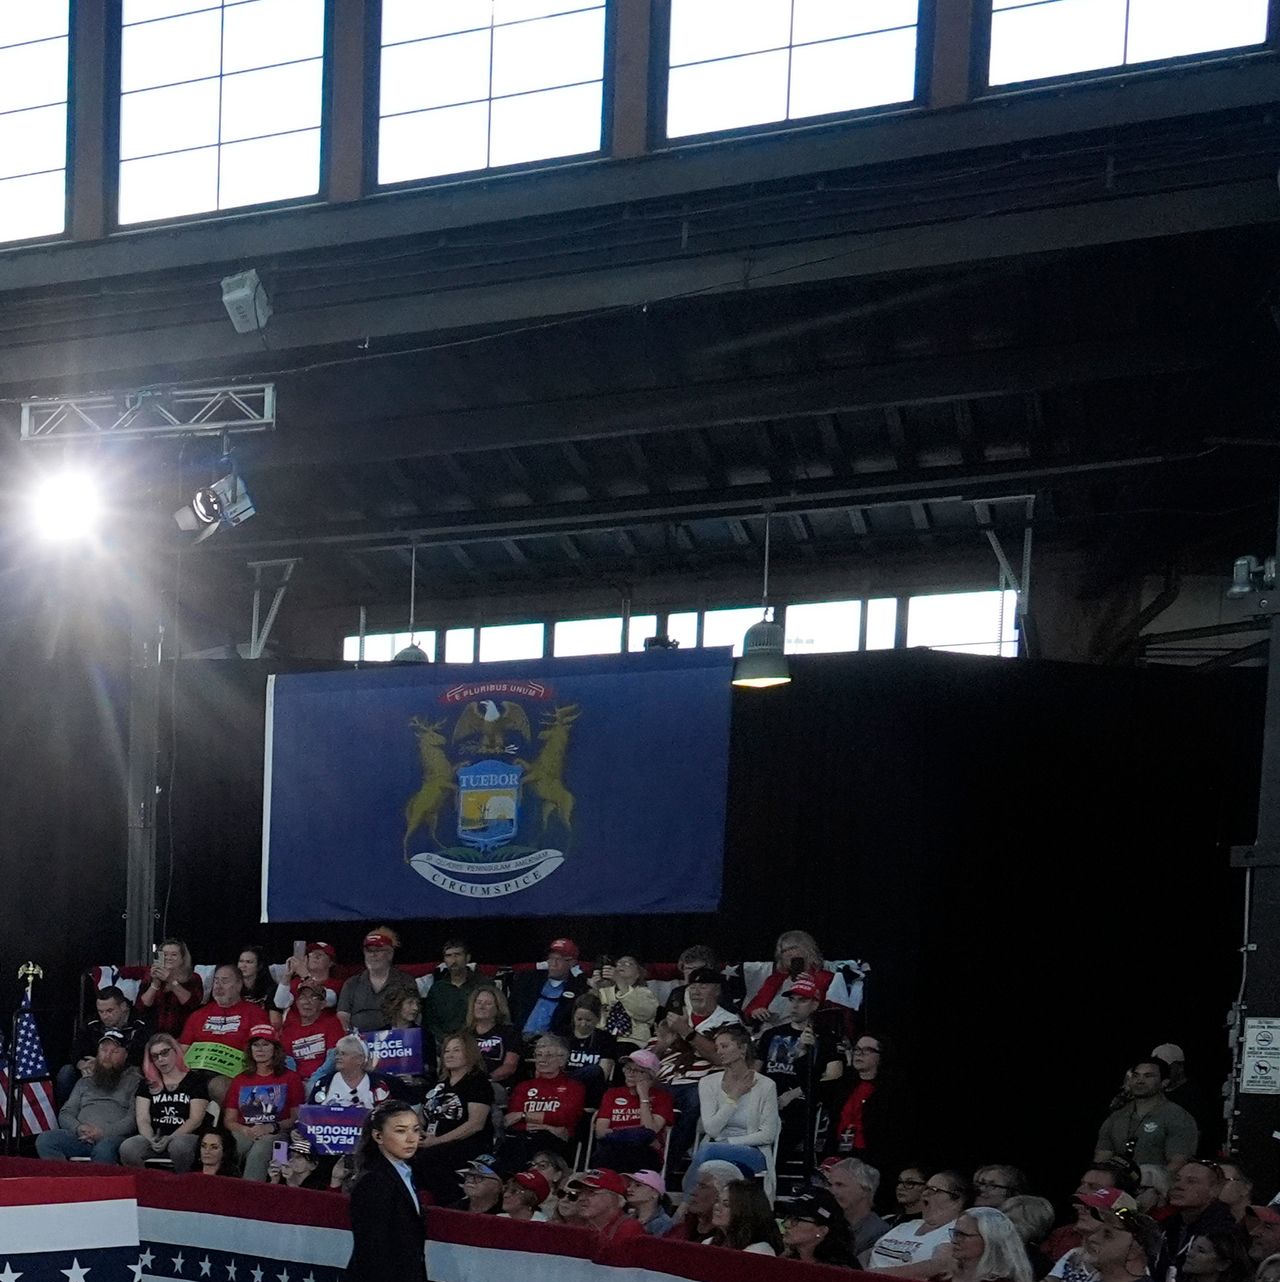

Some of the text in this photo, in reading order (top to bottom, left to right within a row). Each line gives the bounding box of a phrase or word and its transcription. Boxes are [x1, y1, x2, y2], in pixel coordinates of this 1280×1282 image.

[464, 684, 508, 697] PLURIBUS
[510, 686, 537, 697] UNUM
[459, 772, 519, 788] TUEBOR
[432, 871, 542, 896] CIRCUMSPICE
[523, 1100, 561, 1112] TRUMP
[315, 1135, 356, 1145] PEACE
